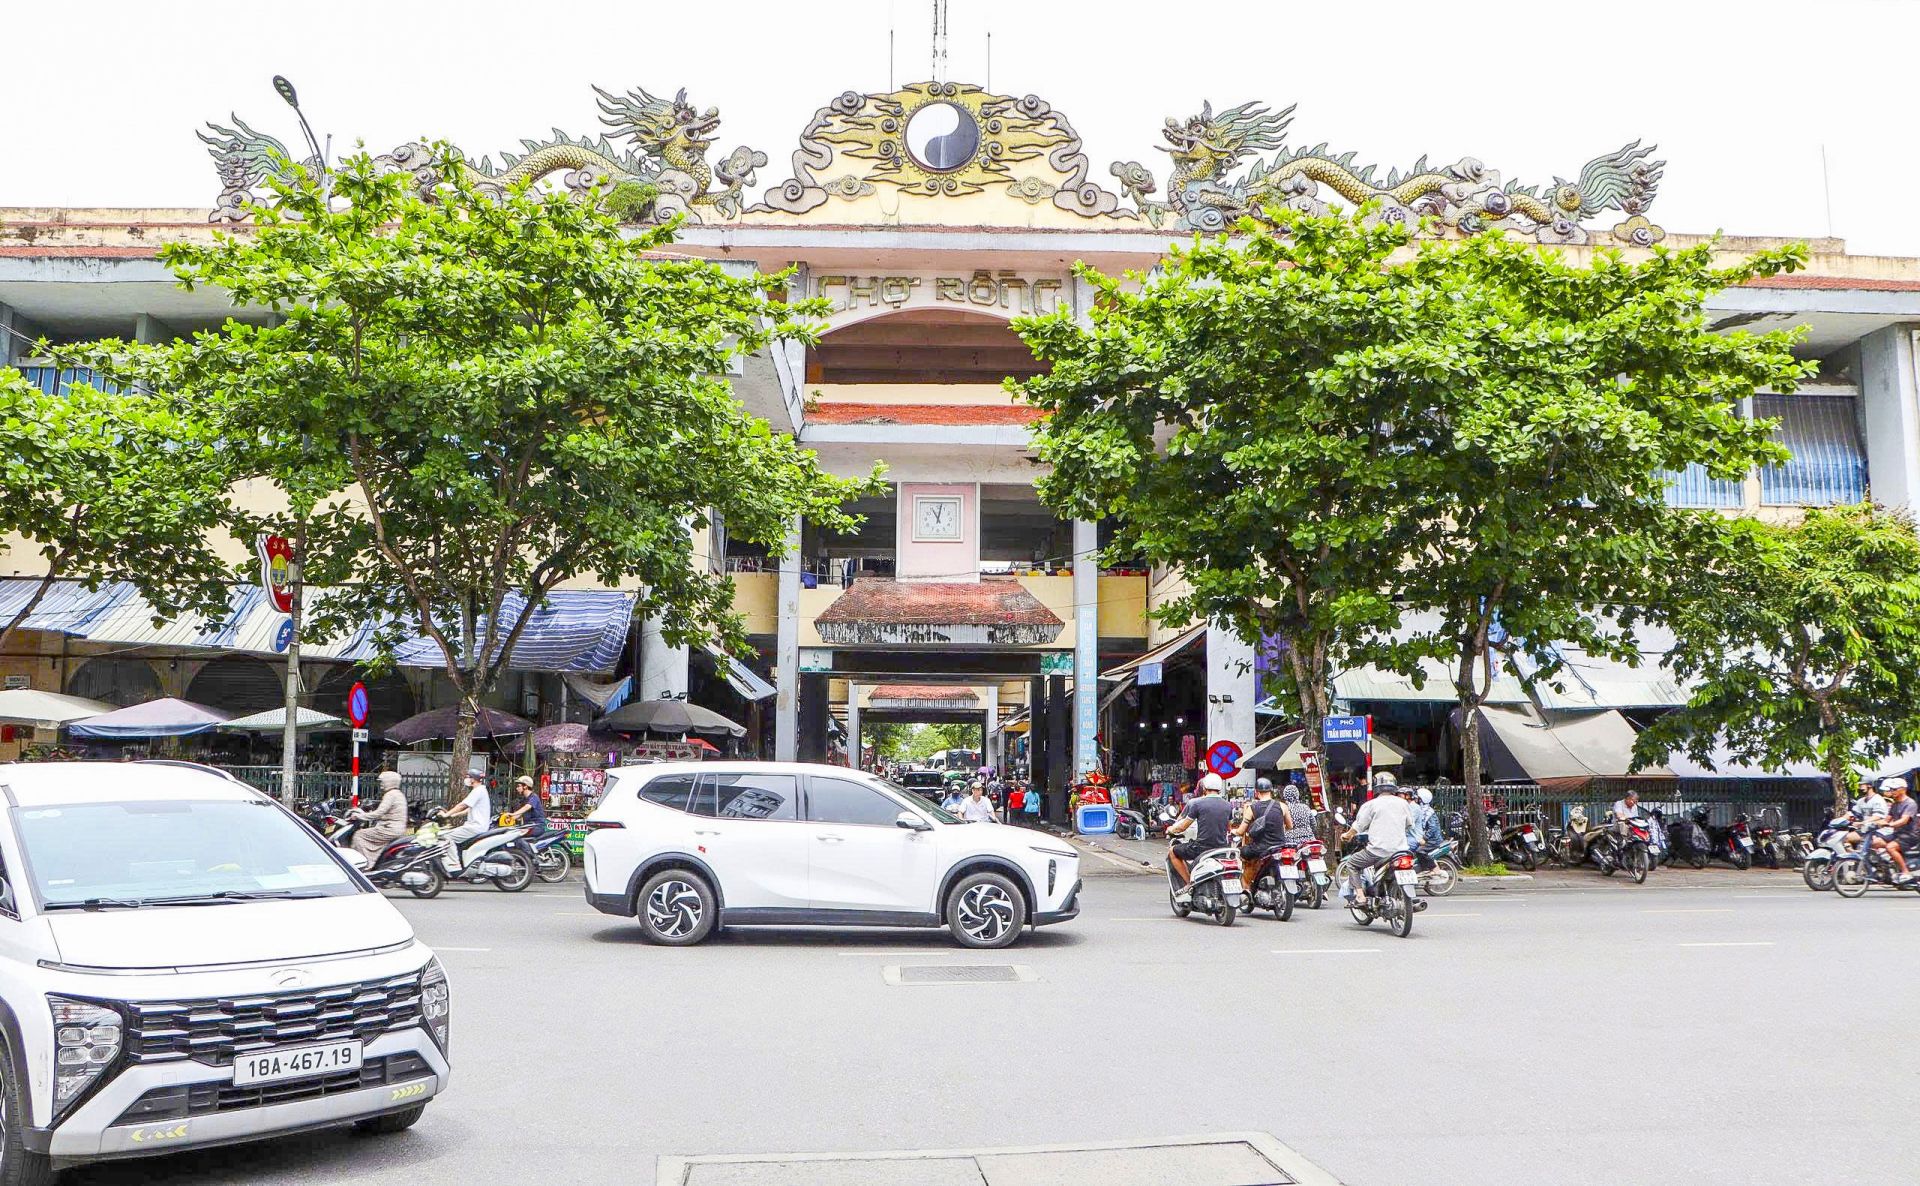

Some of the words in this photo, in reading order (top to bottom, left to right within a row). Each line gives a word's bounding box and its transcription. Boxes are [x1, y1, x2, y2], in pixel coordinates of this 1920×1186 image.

[817, 275, 921, 319] CHỢ
[1340, 717, 1354, 726] PHỐ
[249, 1048, 352, 1077] 18A-467.19
